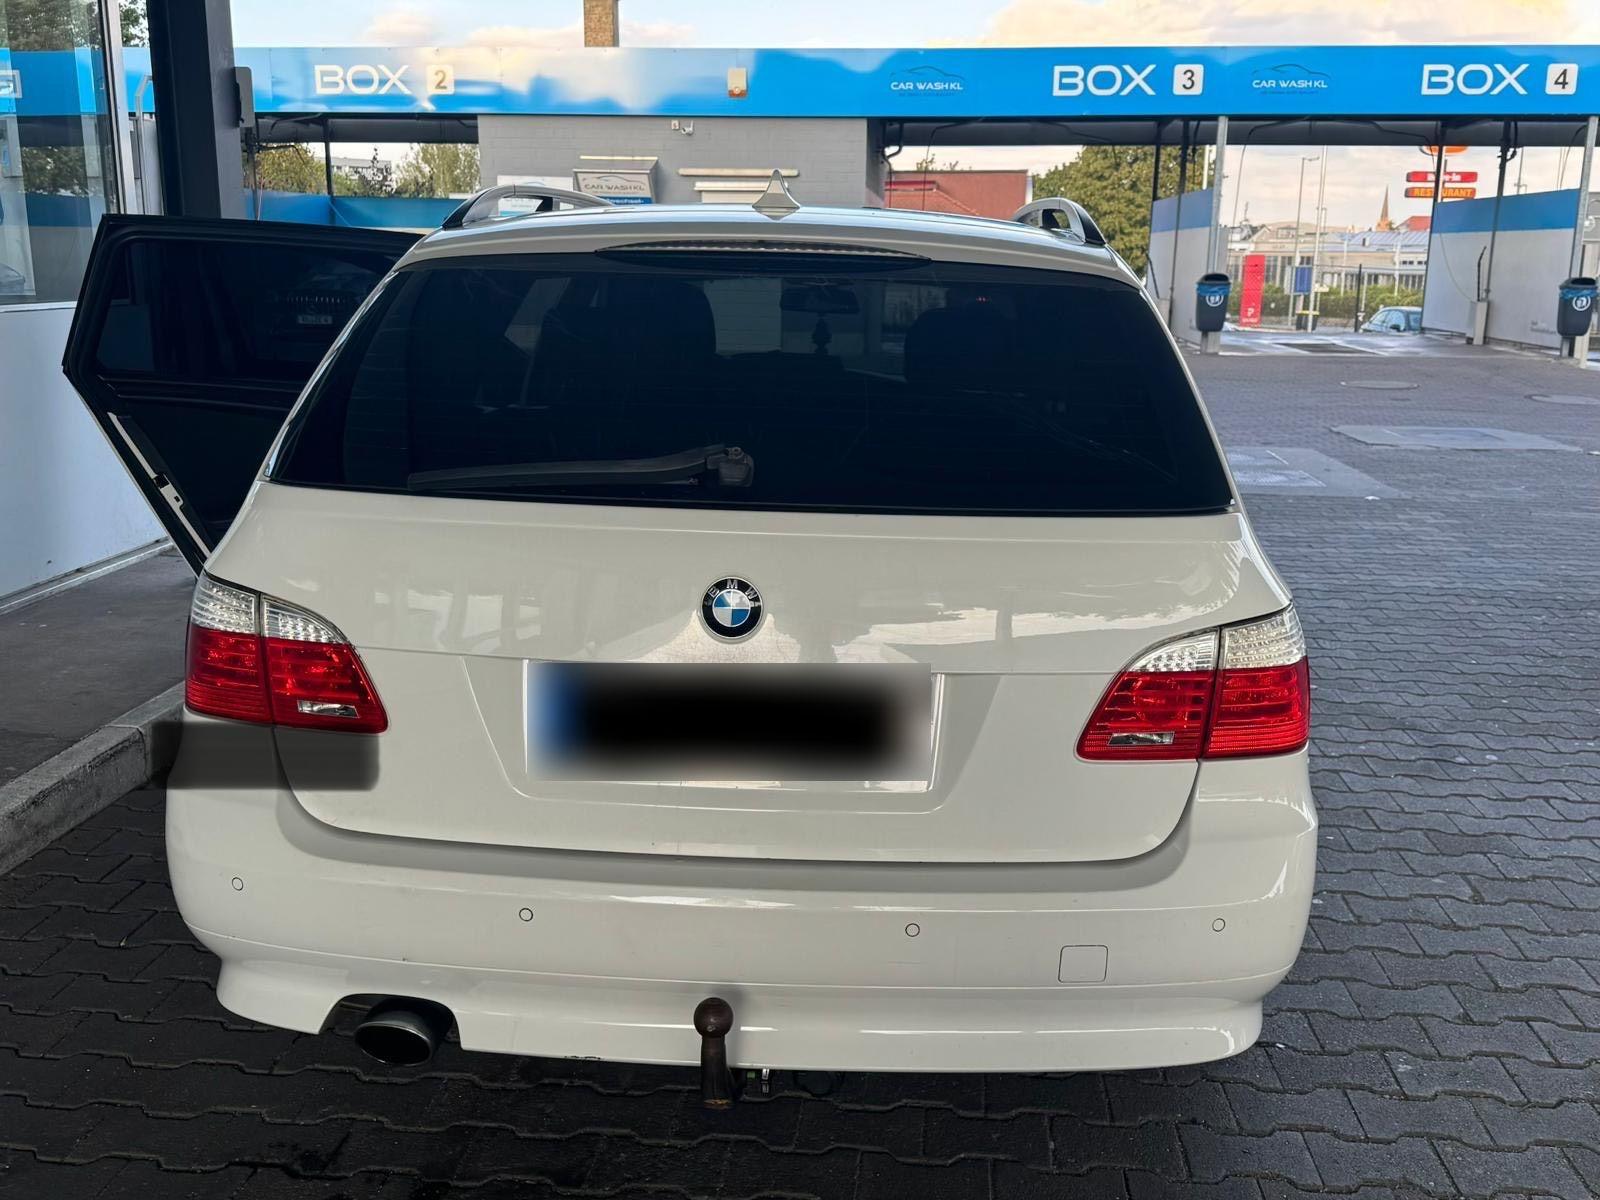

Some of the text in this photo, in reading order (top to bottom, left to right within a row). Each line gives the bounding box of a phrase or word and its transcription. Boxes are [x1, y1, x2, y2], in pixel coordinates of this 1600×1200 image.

[314, 64, 448, 95] BOX 2
[890, 81, 914, 90] CAR
[916, 81, 948, 90] WASH
[1052, 64, 1195, 97] BOX 3
[1252, 79, 1276, 88] CAR
[1279, 79, 1312, 88] WASH
[1421, 63, 1569, 96] BOX 4
[708, 579, 758, 600] BMW
